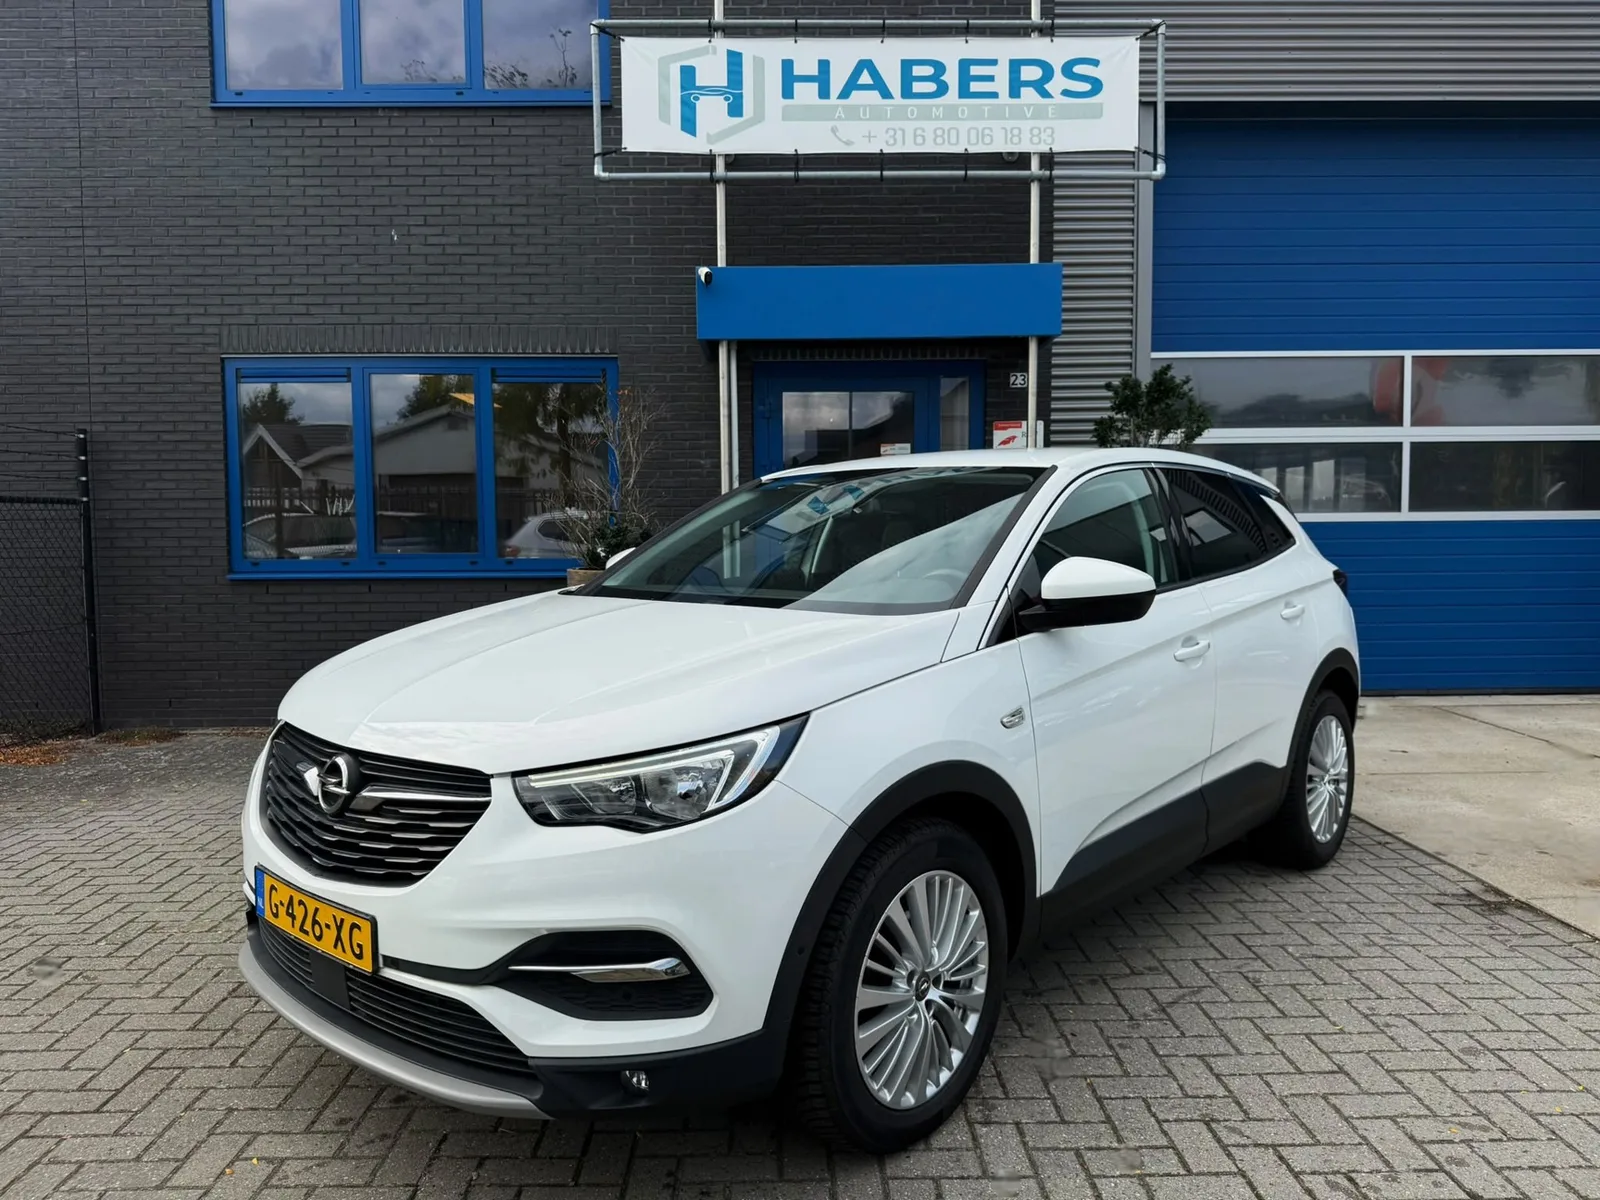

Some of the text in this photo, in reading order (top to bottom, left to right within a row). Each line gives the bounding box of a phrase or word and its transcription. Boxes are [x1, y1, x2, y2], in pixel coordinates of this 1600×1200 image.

[781, 57, 1104, 100] HABERS
[834, 106, 1057, 119] AUTOMOTIVE
[932, 127, 960, 147] 80
[966, 127, 994, 147] 06
[1001, 127, 1022, 147] 18
[1029, 126, 1056, 146] 83
[1010, 373, 1027, 387] 23
[268, 883, 364, 961] G-426-XG
